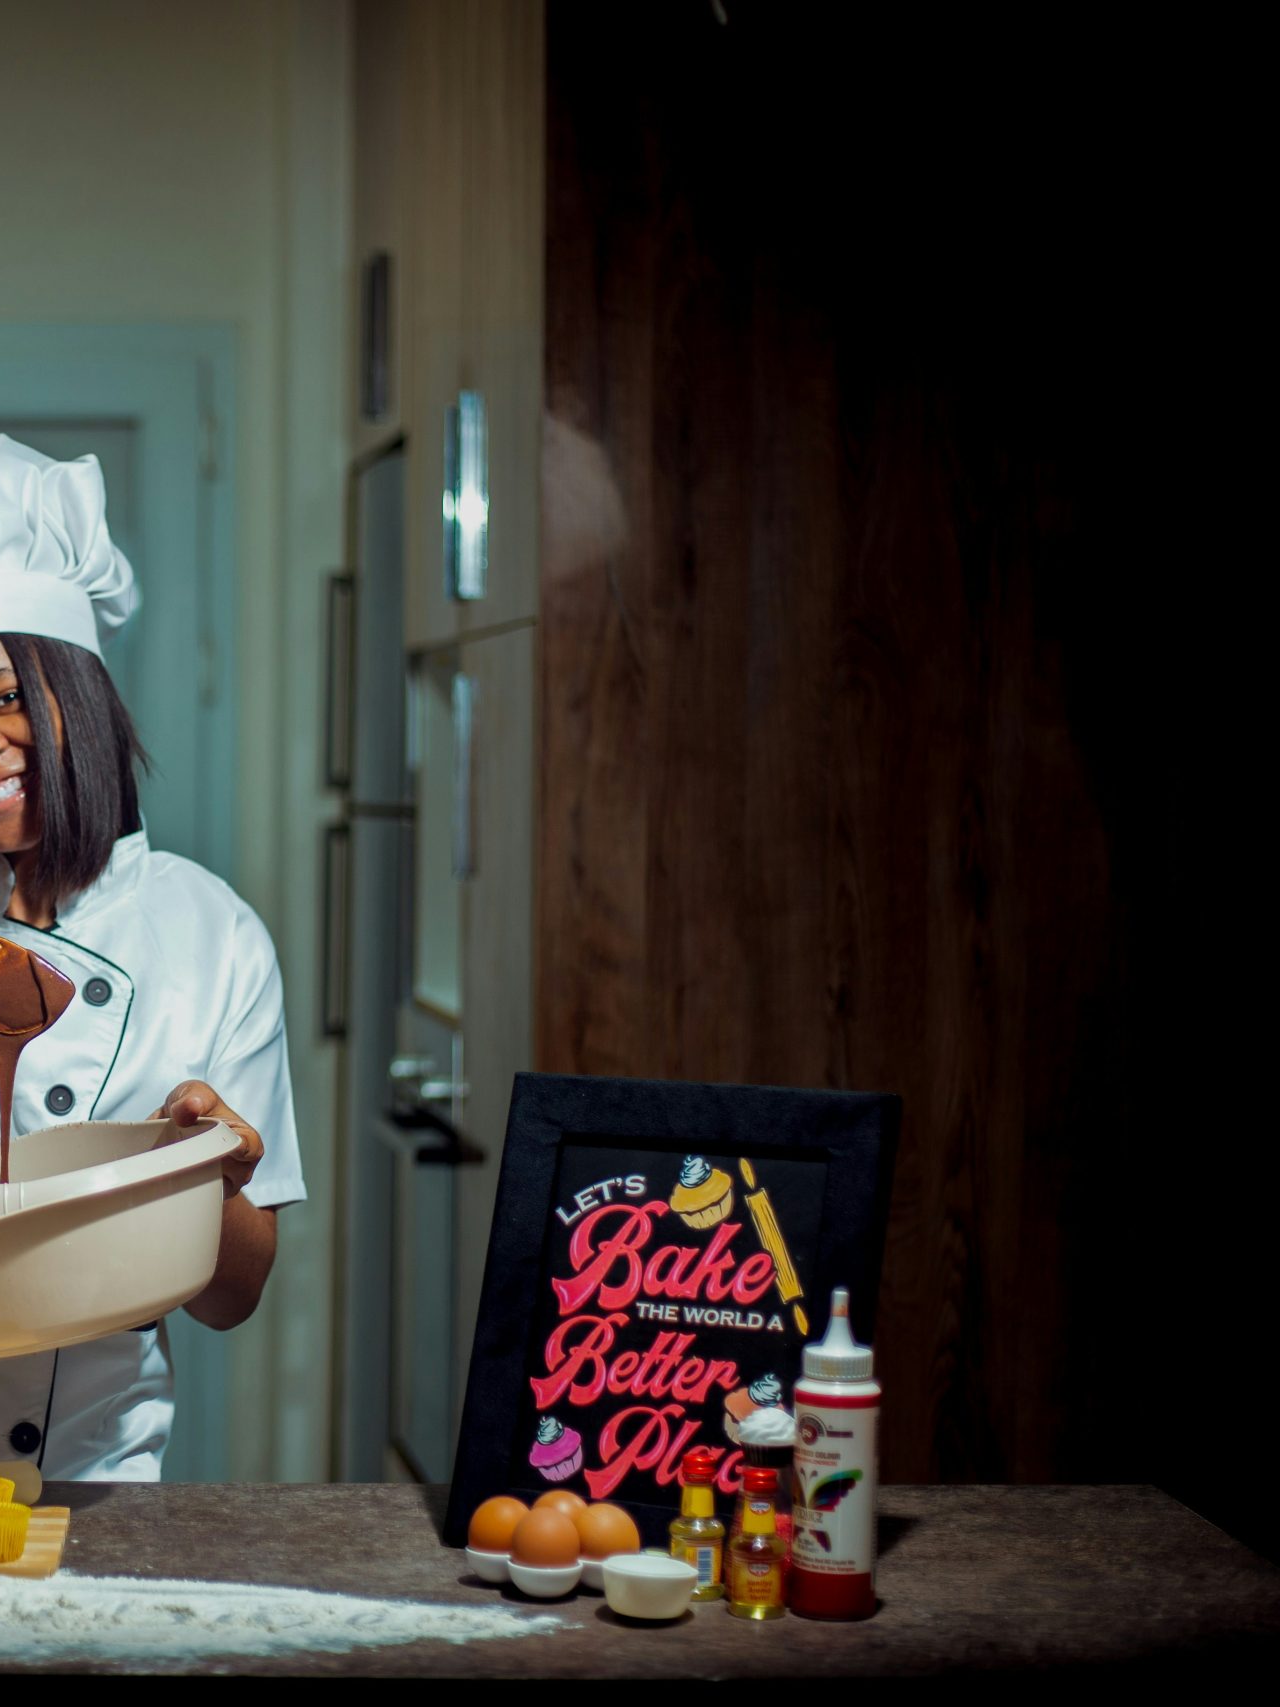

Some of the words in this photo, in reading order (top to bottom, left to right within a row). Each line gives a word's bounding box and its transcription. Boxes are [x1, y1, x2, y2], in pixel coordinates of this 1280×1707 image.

[555, 1175, 647, 1226] LET'S
[551, 1200, 778, 1317] Bake
[529, 1312, 741, 1411] Better
[635, 1302, 679, 1321] THE
[683, 1307, 763, 1329] WORLD
[767, 1315, 784, 1332] A
[583, 1403, 746, 1500] Plc
